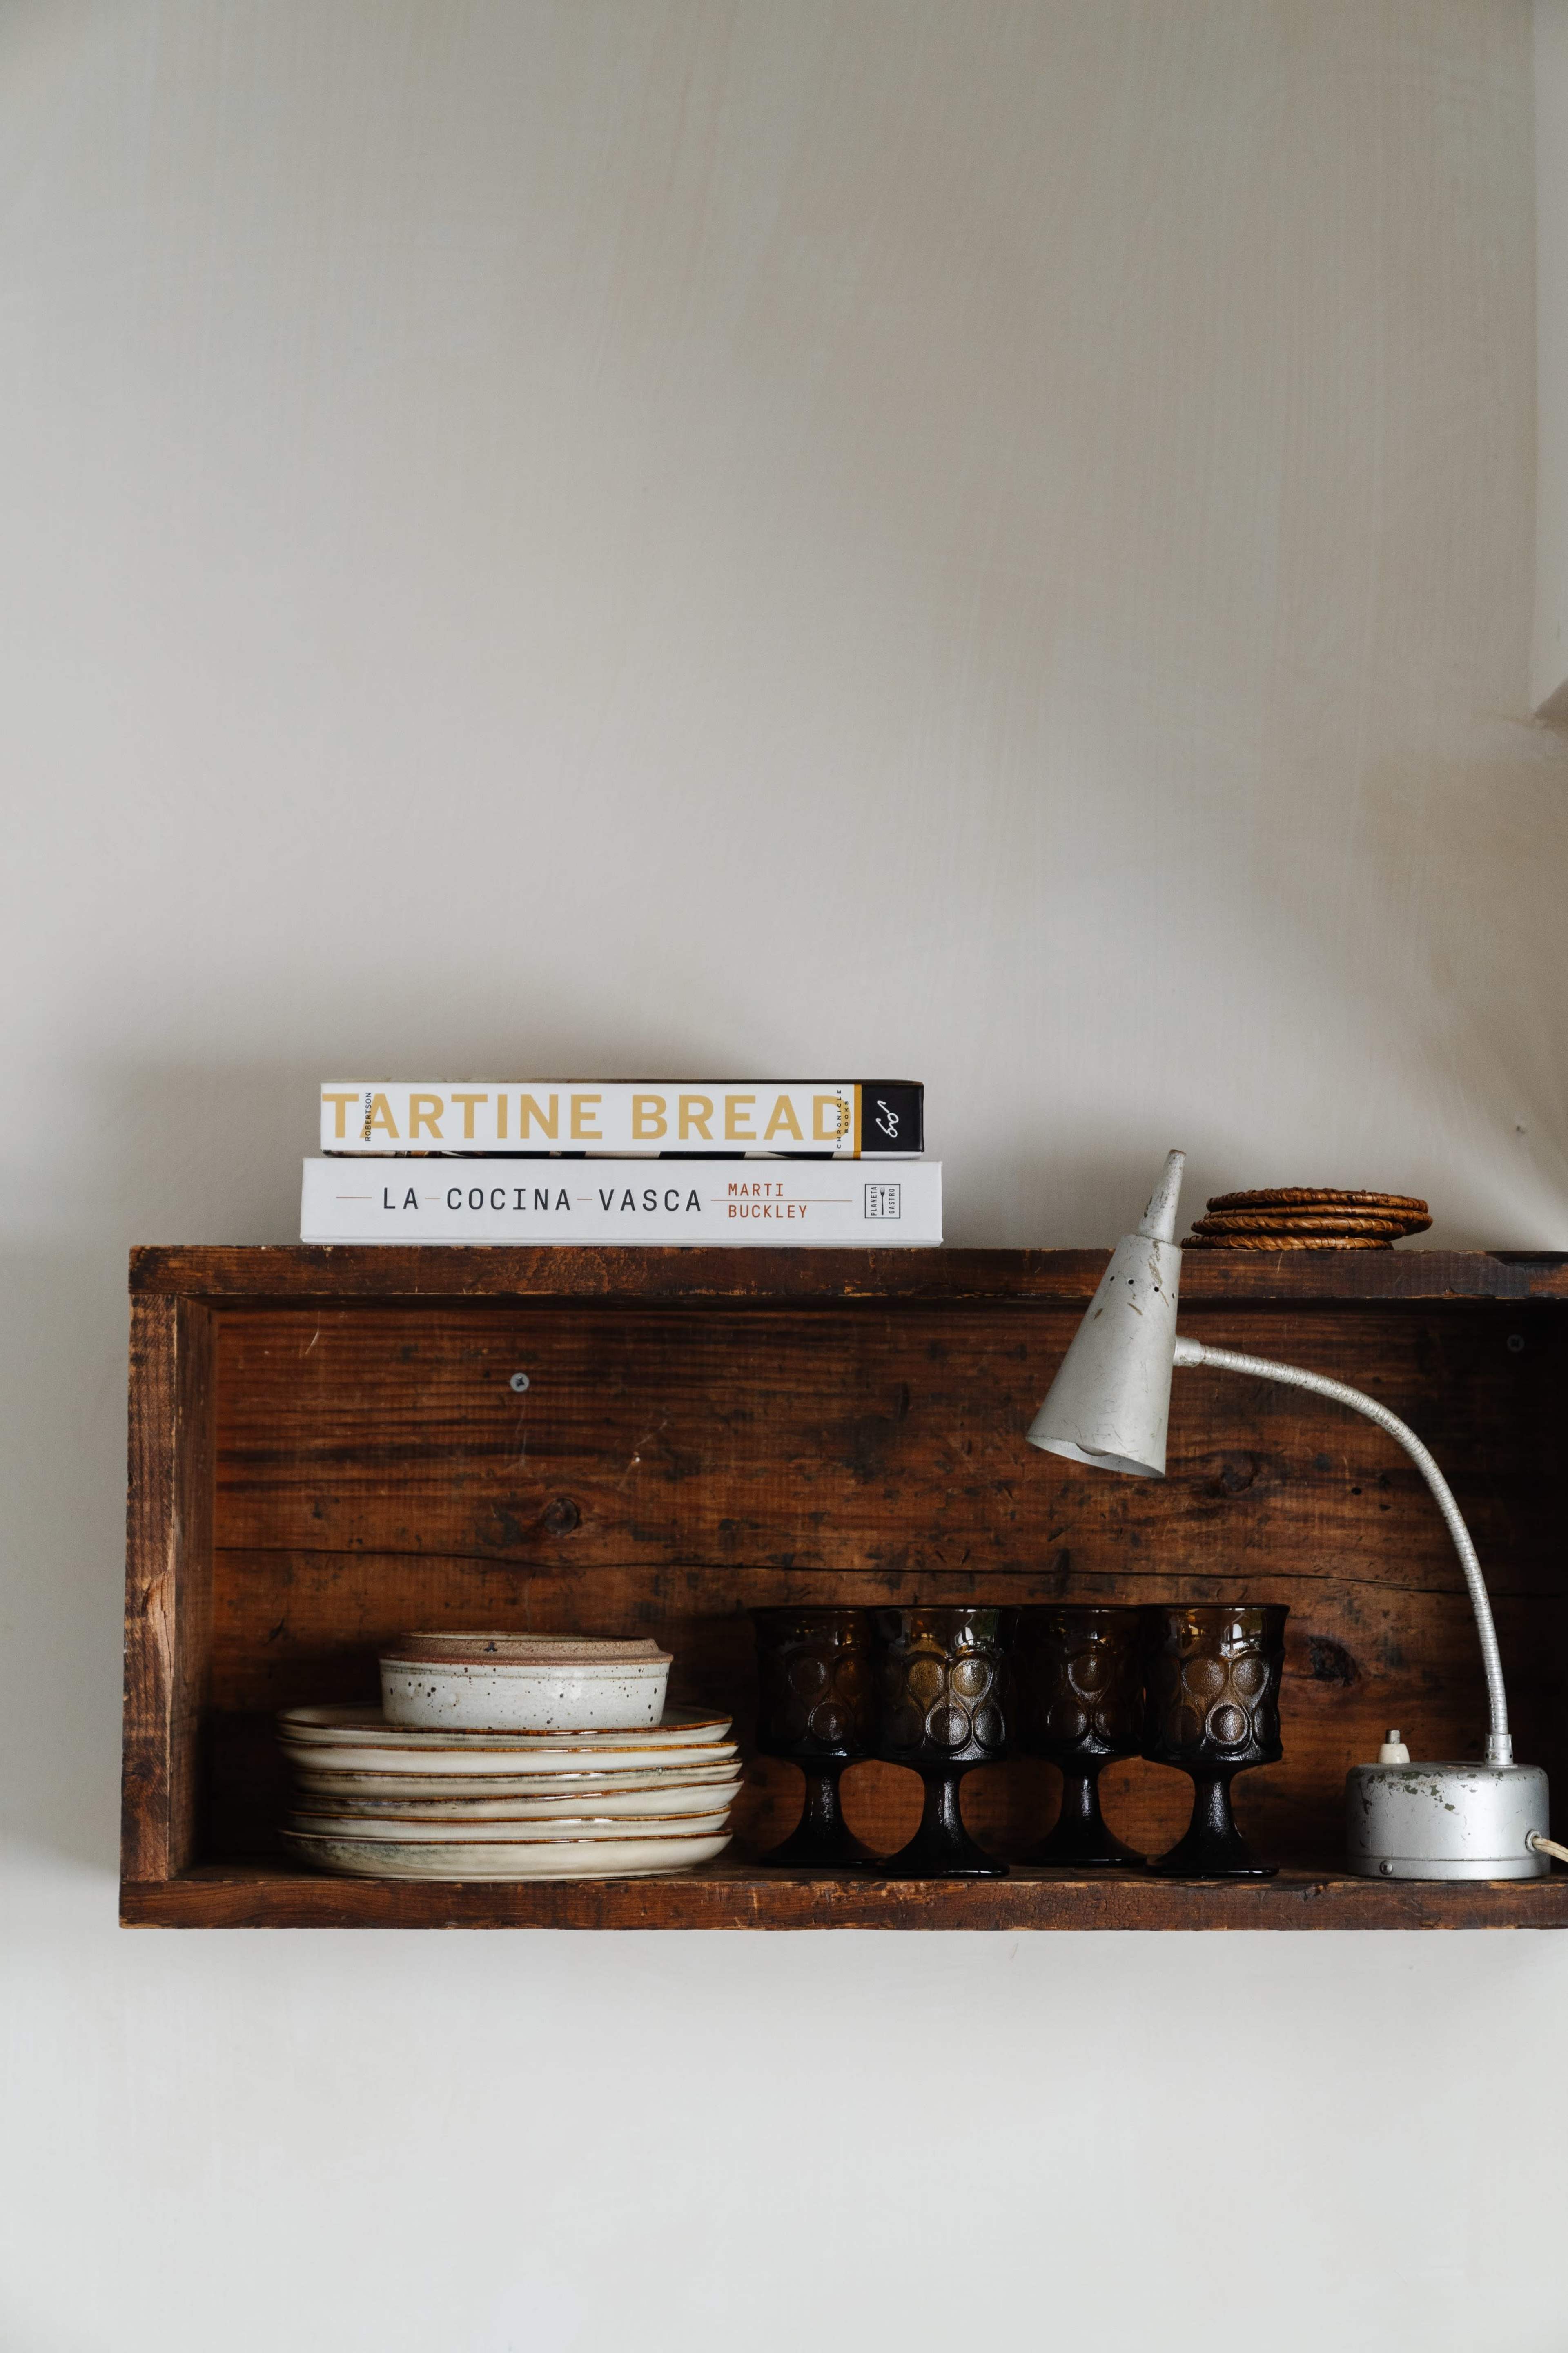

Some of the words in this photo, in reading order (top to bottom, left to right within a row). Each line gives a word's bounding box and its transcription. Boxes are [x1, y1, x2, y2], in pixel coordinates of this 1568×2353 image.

[322, 1093, 603, 1139] TARTINE
[632, 1095, 851, 1140] BREAD
[383, 1187, 419, 1210] LA
[446, 1188, 571, 1211] COCINA
[599, 1189, 701, 1212] VASCA
[728, 1182, 784, 1197] MARTI
[728, 1204, 807, 1218] BUCKLEY
